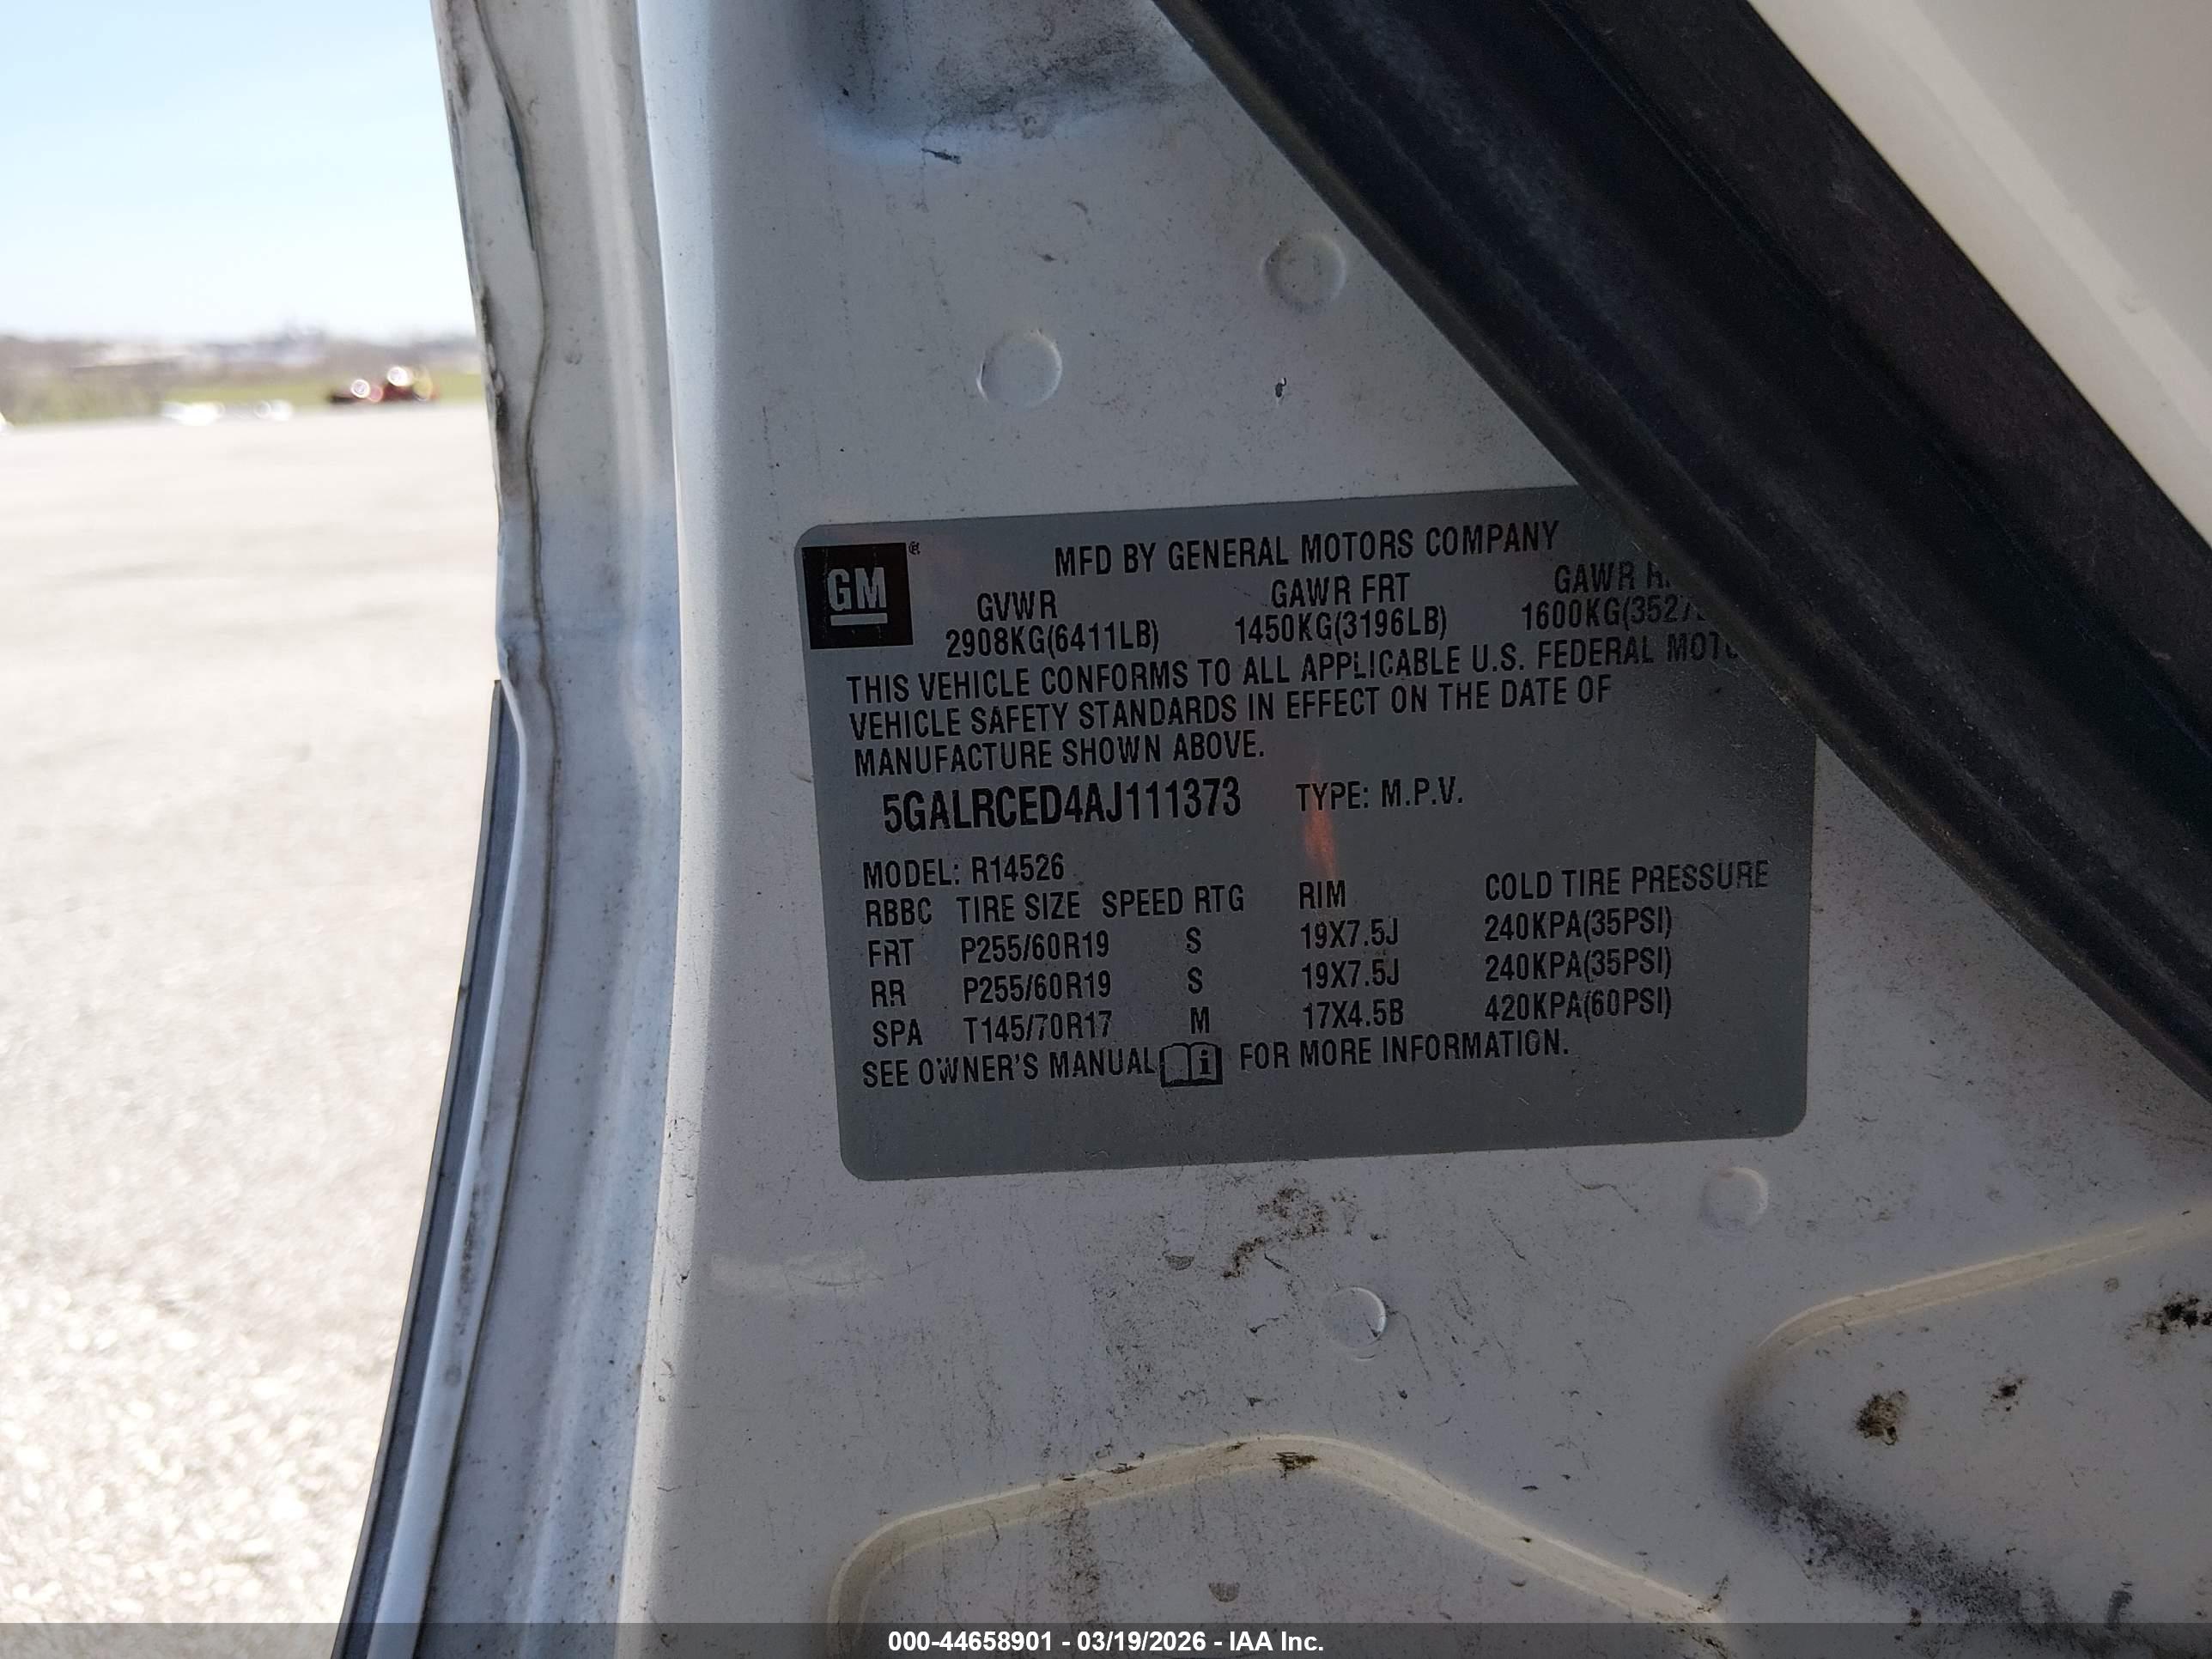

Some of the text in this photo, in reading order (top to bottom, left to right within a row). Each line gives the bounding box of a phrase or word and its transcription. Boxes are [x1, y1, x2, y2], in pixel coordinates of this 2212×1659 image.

[1054, 520, 1560, 578] MFD BY GENERAL MOTORS COMPANY
[827, 568, 887, 611] GM
[1270, 571, 1412, 610] GAWR FRT
[1553, 562, 1641, 599] GAWR
[976, 589, 1058, 623] GVWR
[1521, 592, 1706, 631] 1600KG(352
[945, 618, 1159, 660] 2908KG(6411LB)
[1234, 605, 1448, 648] 1450KG(3196LB)
[845, 673, 910, 705] THIS
[917, 666, 1031, 706] VEHICLE
[1040, 657, 1189, 696] CONFORMS
[1196, 657, 1231, 688] TO
[1242, 654, 1291, 686] ALL
[1300, 645, 1461, 684] APPLICABLE
[1472, 641, 1526, 673] U.S.
[1537, 634, 1660, 670] FEDERAL
[848, 673, 1613, 745] VEHICLE SAFETY STANDARDS IN EFFECT ON THE DATE OF
[854, 728, 1265, 777] MANUFACTURE SHOWN ABOVE.
[882, 775, 1242, 834] 5GALRCED4AJ111373
[1295, 775, 1463, 812] TYPE: M.P.V.
[862, 851, 1065, 890] MODEL: R14526
[1485, 859, 1770, 902] COLD TIRE PRESSURE
[865, 896, 933, 928] RBBC
[955, 890, 1081, 925] TIRE SIZE
[1101, 883, 1244, 919] SPEED RTG
[1298, 879, 1346, 913] RIM
[1184, 926, 1202, 955] S
[1300, 917, 1399, 951] 19X7.5J
[1483, 905, 1673, 945] 240KPA(35PSI)
[867, 938, 915, 969] FRT
[960, 929, 1109, 965] P255/60R19
[1485, 945, 1672, 984] 240KPA(35PSI)
[963, 967, 1111, 1005] P255/60R19
[1187, 966, 1204, 995] S
[1301, 956, 1400, 990] 19X7.5J
[870, 978, 908, 1008] RR
[1484, 986, 1673, 1024] 420KPA(60PSI)
[963, 1009, 1115, 1046] T145/70R17
[1189, 1006, 1210, 1035] M
[1302, 997, 1404, 1030] 17X4.5B
[872, 1018, 924, 1048] SPA
[1239, 1027, 1569, 1072] FOR MORE INFORMATION.
[861, 1049, 1156, 1089] SEE OWNER'S MANUAL
